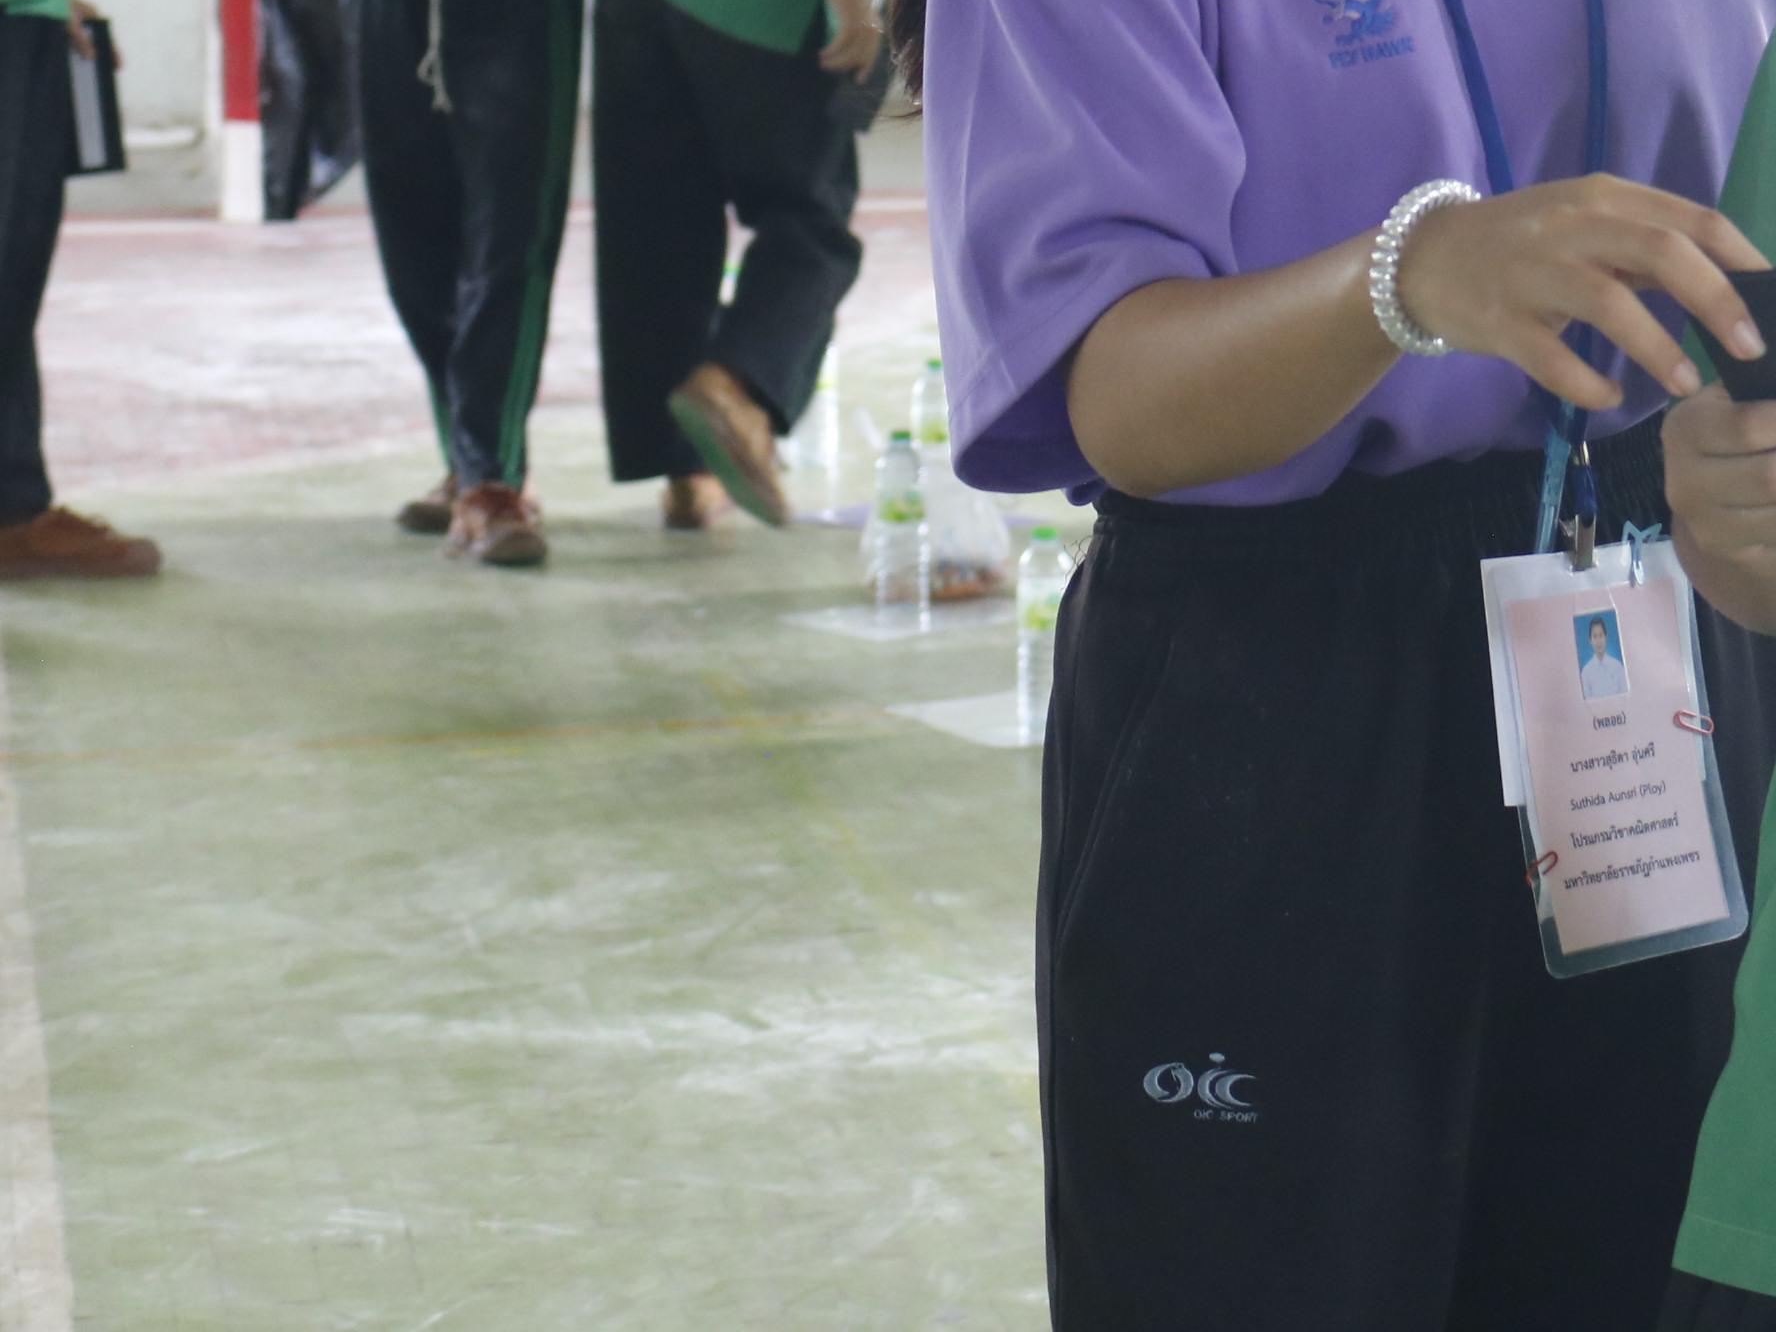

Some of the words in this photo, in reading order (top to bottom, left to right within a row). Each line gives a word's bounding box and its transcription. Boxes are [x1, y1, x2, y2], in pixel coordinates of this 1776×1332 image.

[1570, 793, 1606, 811] Suthida
[1608, 786, 1637, 803] Aunsri
[1639, 780, 1666, 797] (Ploy)
[1570, 811, 1679, 848] โปรแกรมวิชาคณิตศาสตร์
